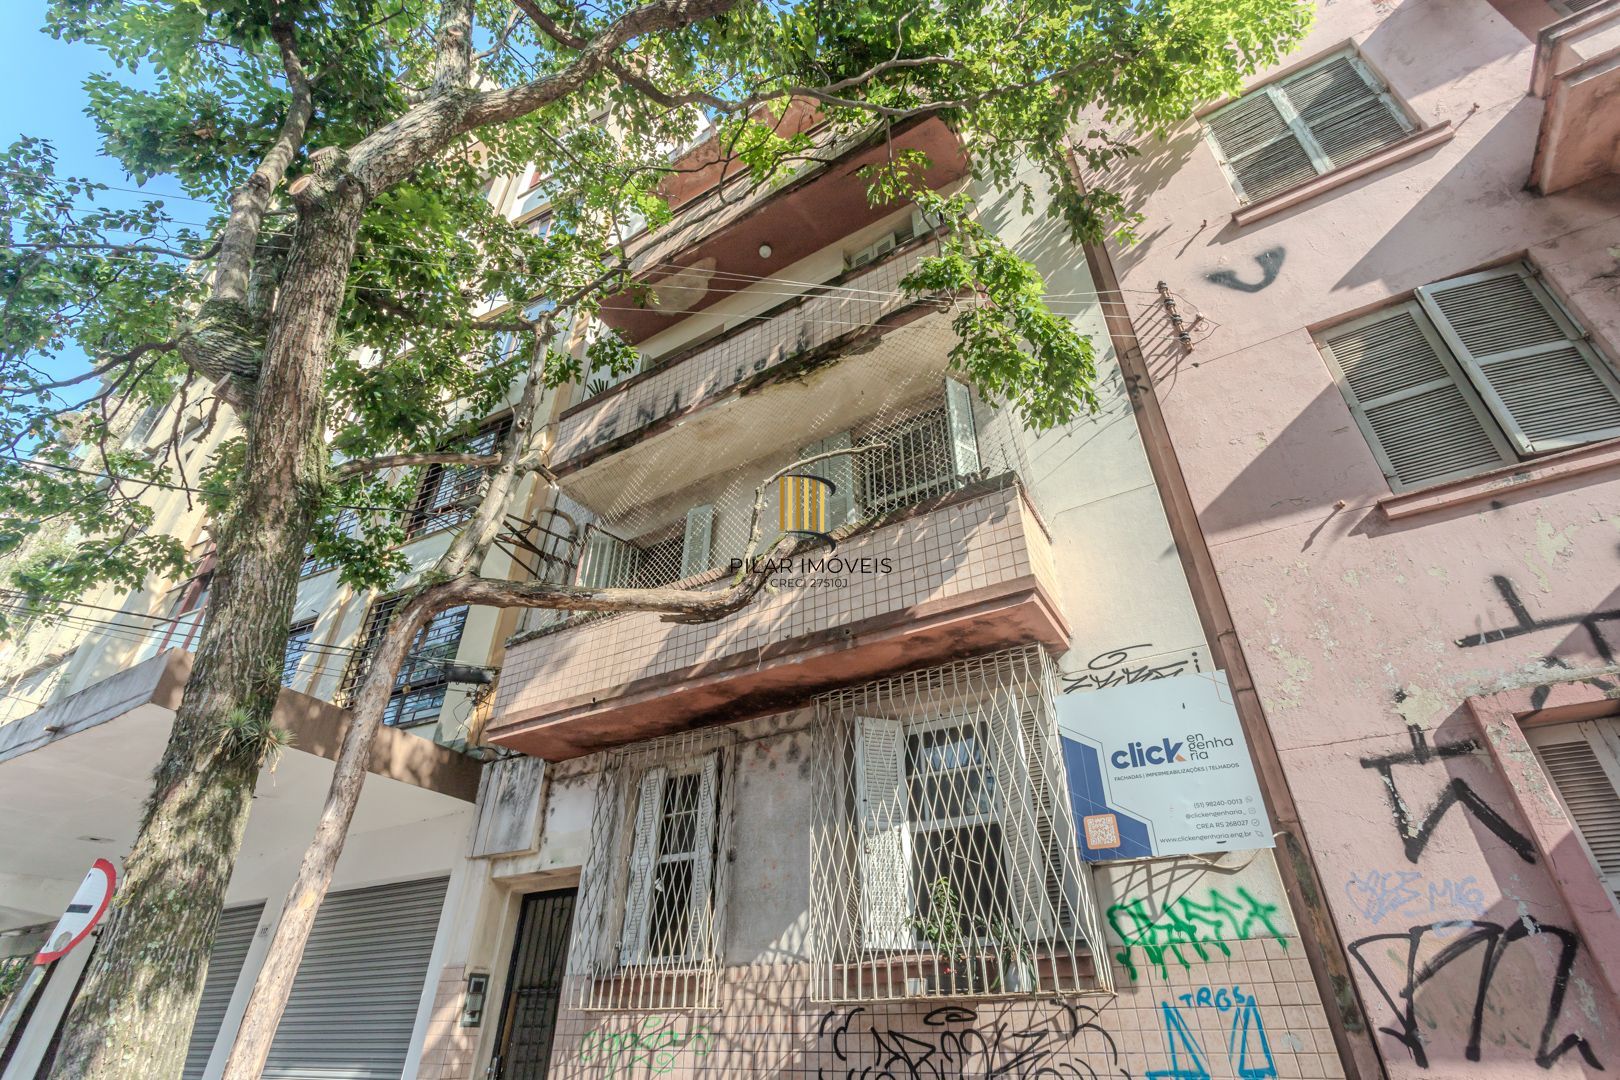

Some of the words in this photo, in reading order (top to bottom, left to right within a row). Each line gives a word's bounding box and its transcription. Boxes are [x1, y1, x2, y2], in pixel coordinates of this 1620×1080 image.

[1187, 733, 1205, 743] en
[1111, 738, 1185, 769] click
[1188, 737, 1234, 752] genha
[1190, 750, 1209, 761] ria
[1208, 763, 1240, 771] TELHADOS
